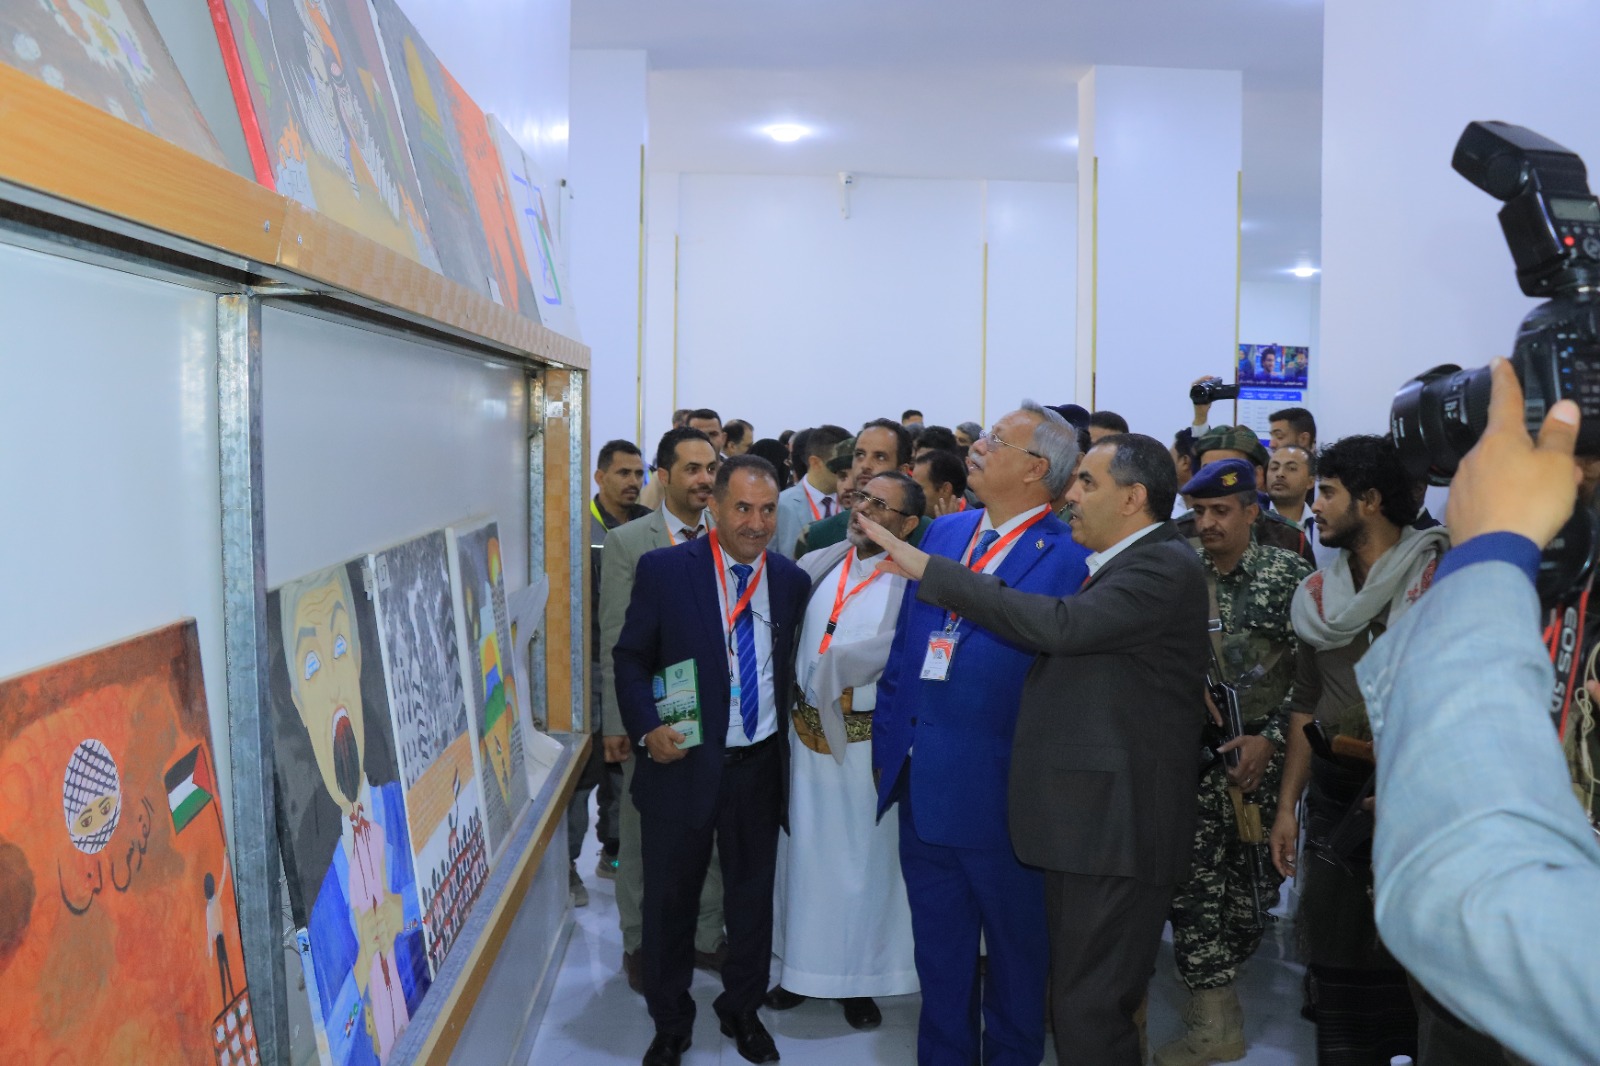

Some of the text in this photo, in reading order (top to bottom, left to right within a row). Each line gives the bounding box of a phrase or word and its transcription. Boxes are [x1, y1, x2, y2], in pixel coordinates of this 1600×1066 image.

[1558, 606, 1578, 674] EOS
[57, 796, 155, 916] القدس لنا
